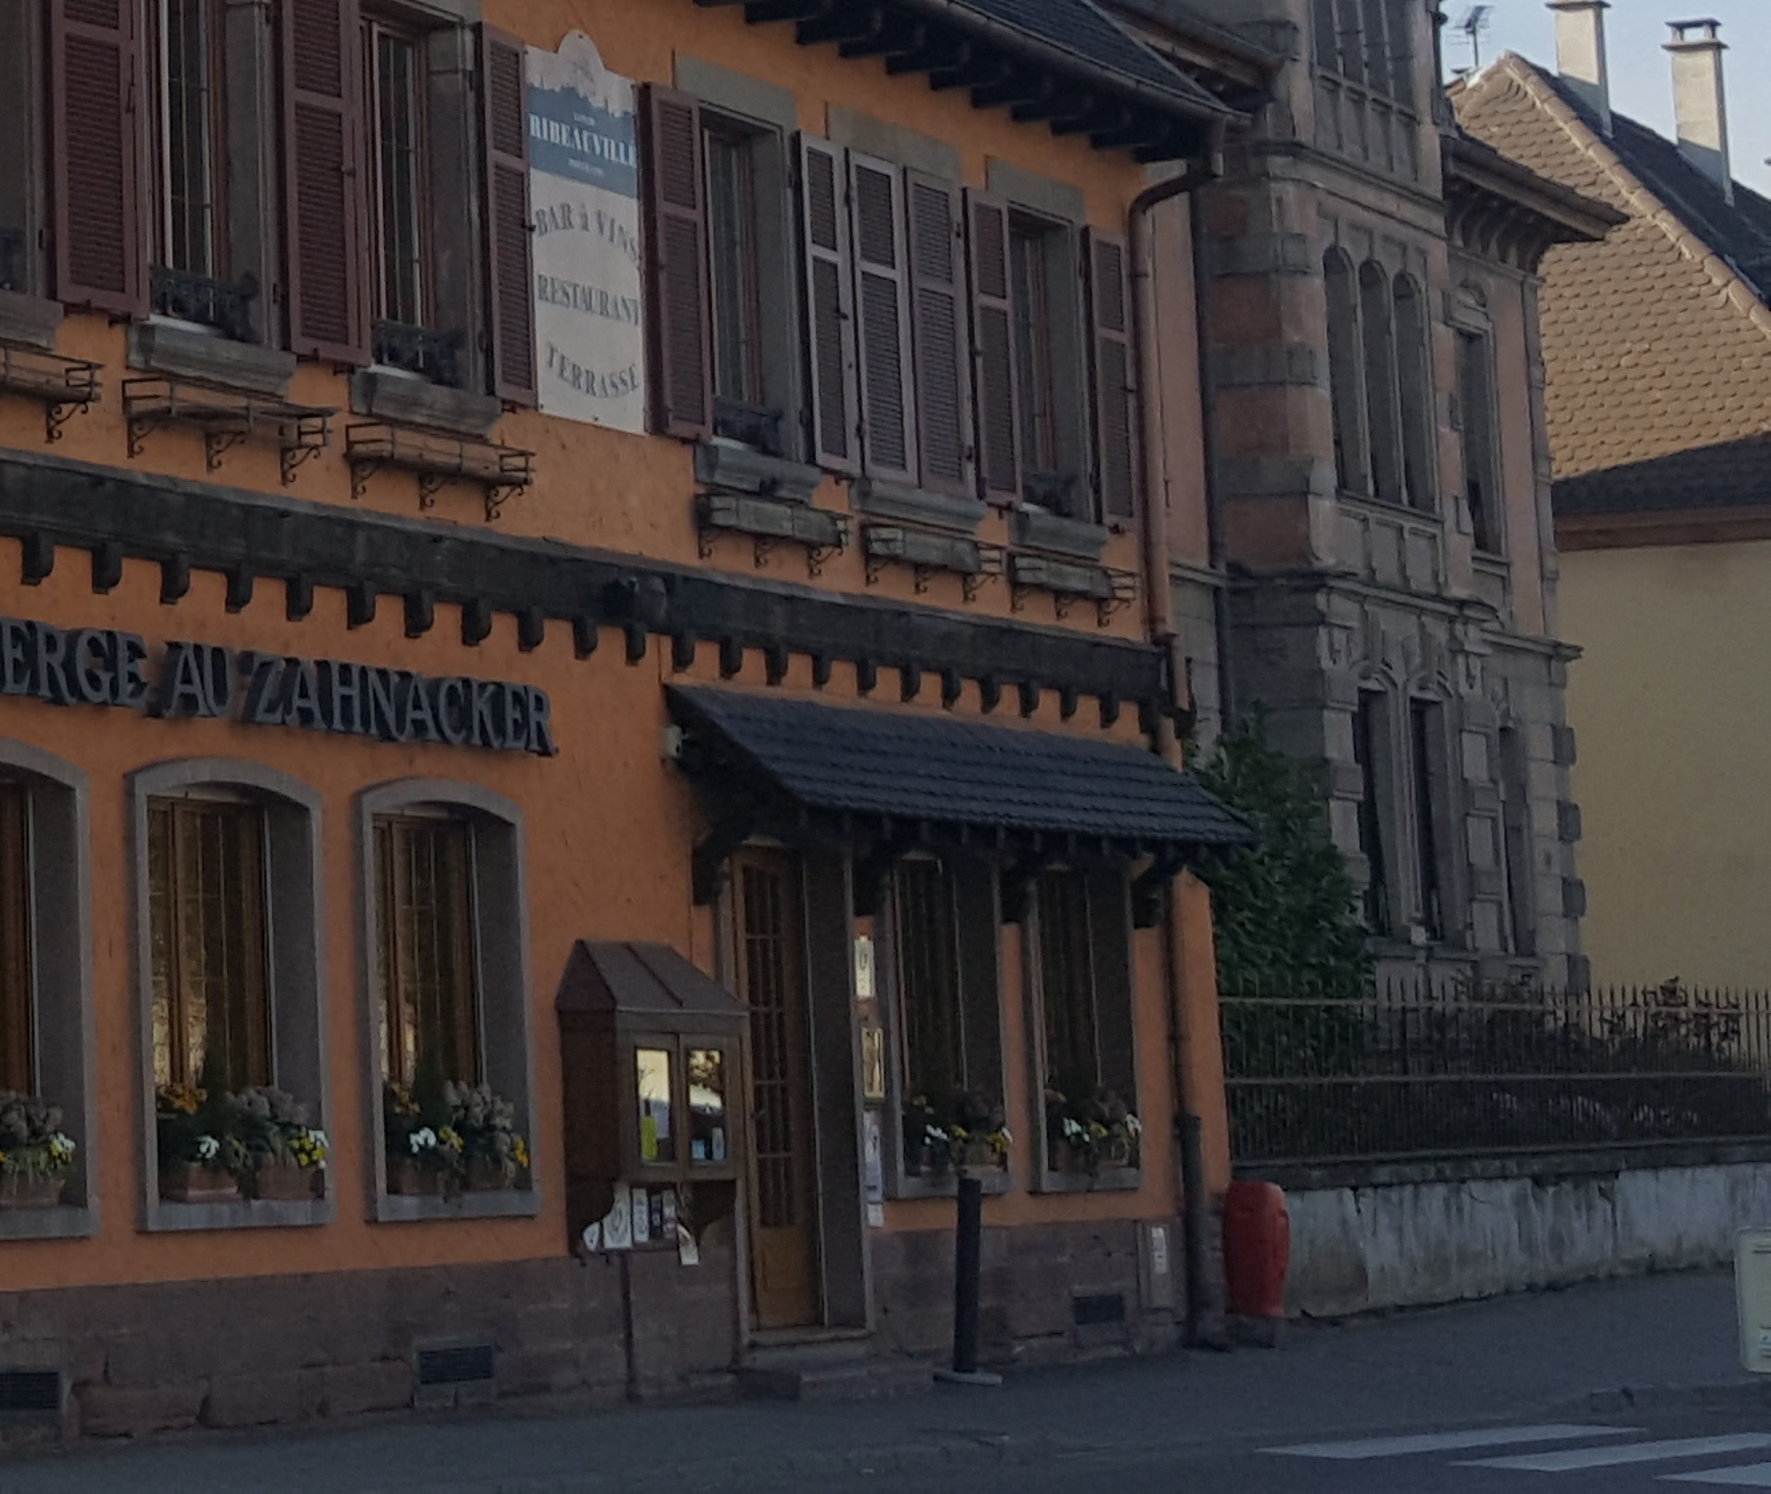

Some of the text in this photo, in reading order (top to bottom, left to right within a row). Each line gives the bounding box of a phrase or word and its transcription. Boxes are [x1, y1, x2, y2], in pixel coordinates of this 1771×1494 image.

[535, 202, 574, 238] BAR
[595, 208, 638, 263] VINS
[537, 273, 639, 326] RESTAURANT
[547, 340, 640, 399] TERRASSE
[157, 640, 231, 719] AU
[241, 651, 558, 758] ZAHNACKER
